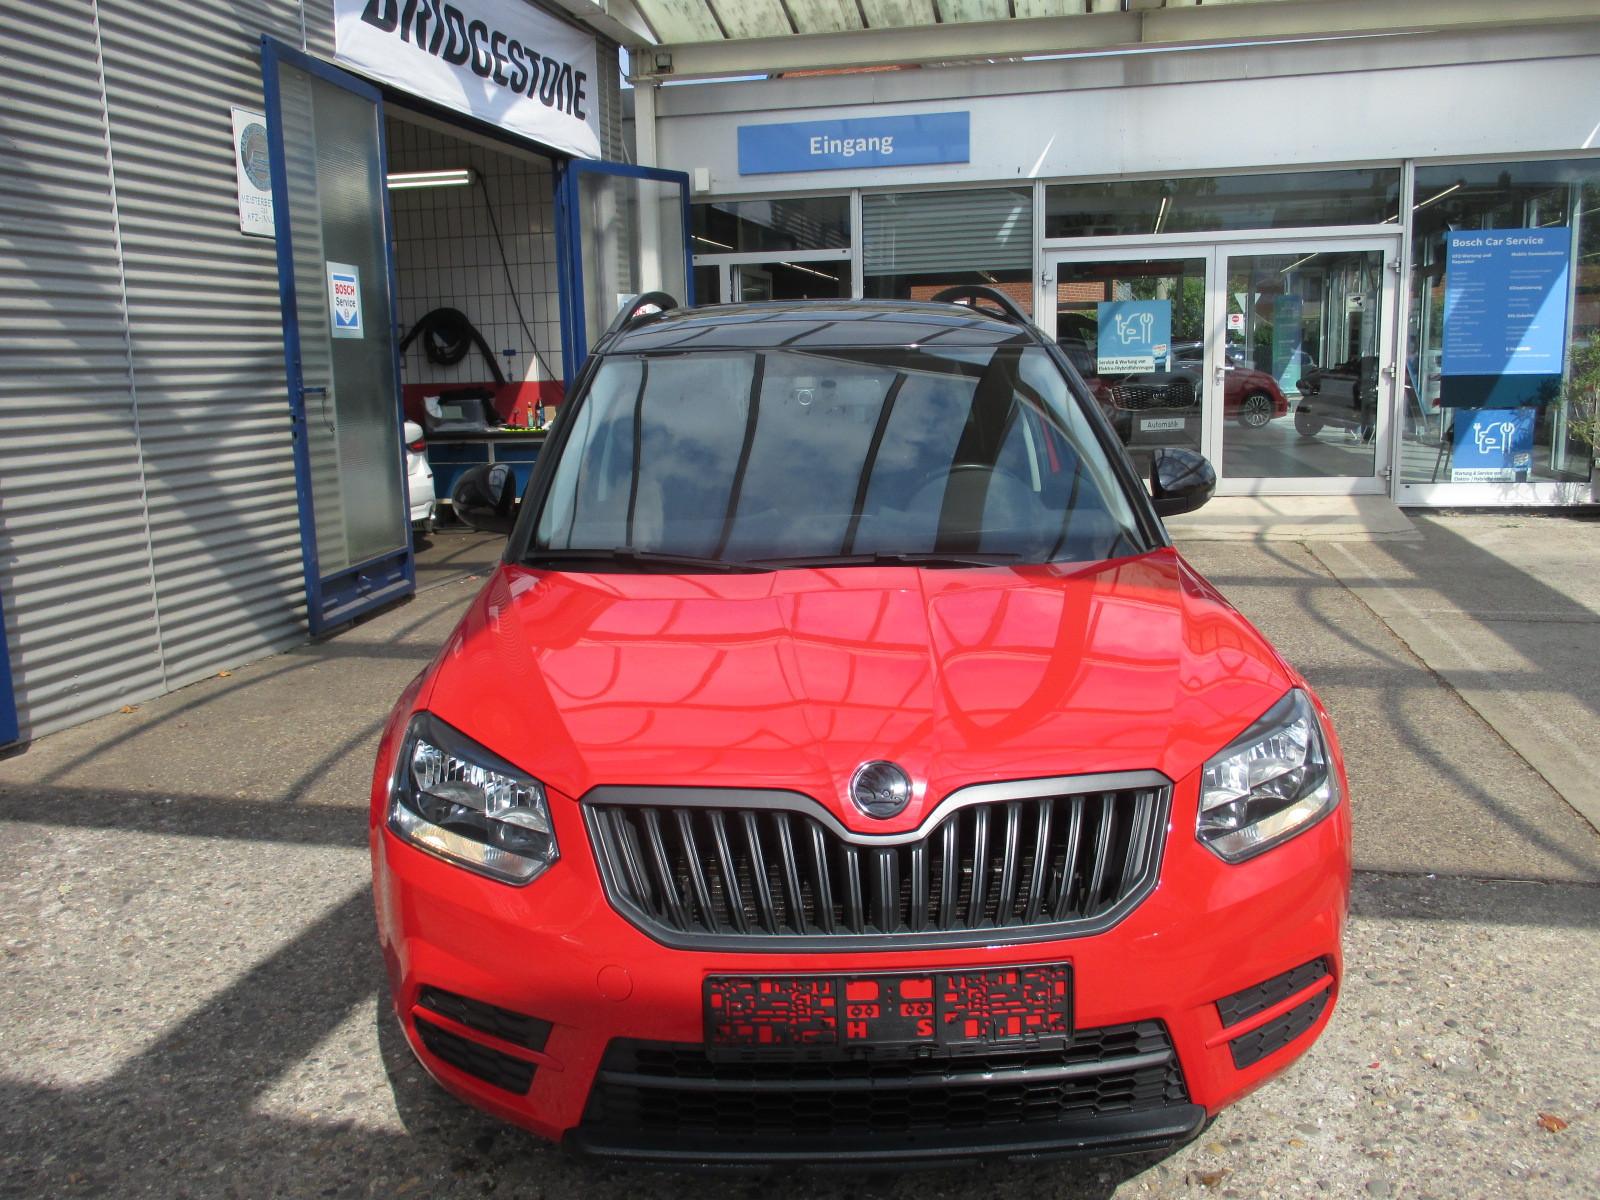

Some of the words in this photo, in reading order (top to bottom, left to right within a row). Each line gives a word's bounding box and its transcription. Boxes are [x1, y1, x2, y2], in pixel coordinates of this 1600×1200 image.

[810, 136, 893, 156] Eingang
[1452, 238, 1482, 247] Bosch
[1486, 238, 1503, 246] Car
[1506, 236, 1544, 246] Service
[335, 283, 355, 296] BOSCH
[336, 296, 356, 308] Service
